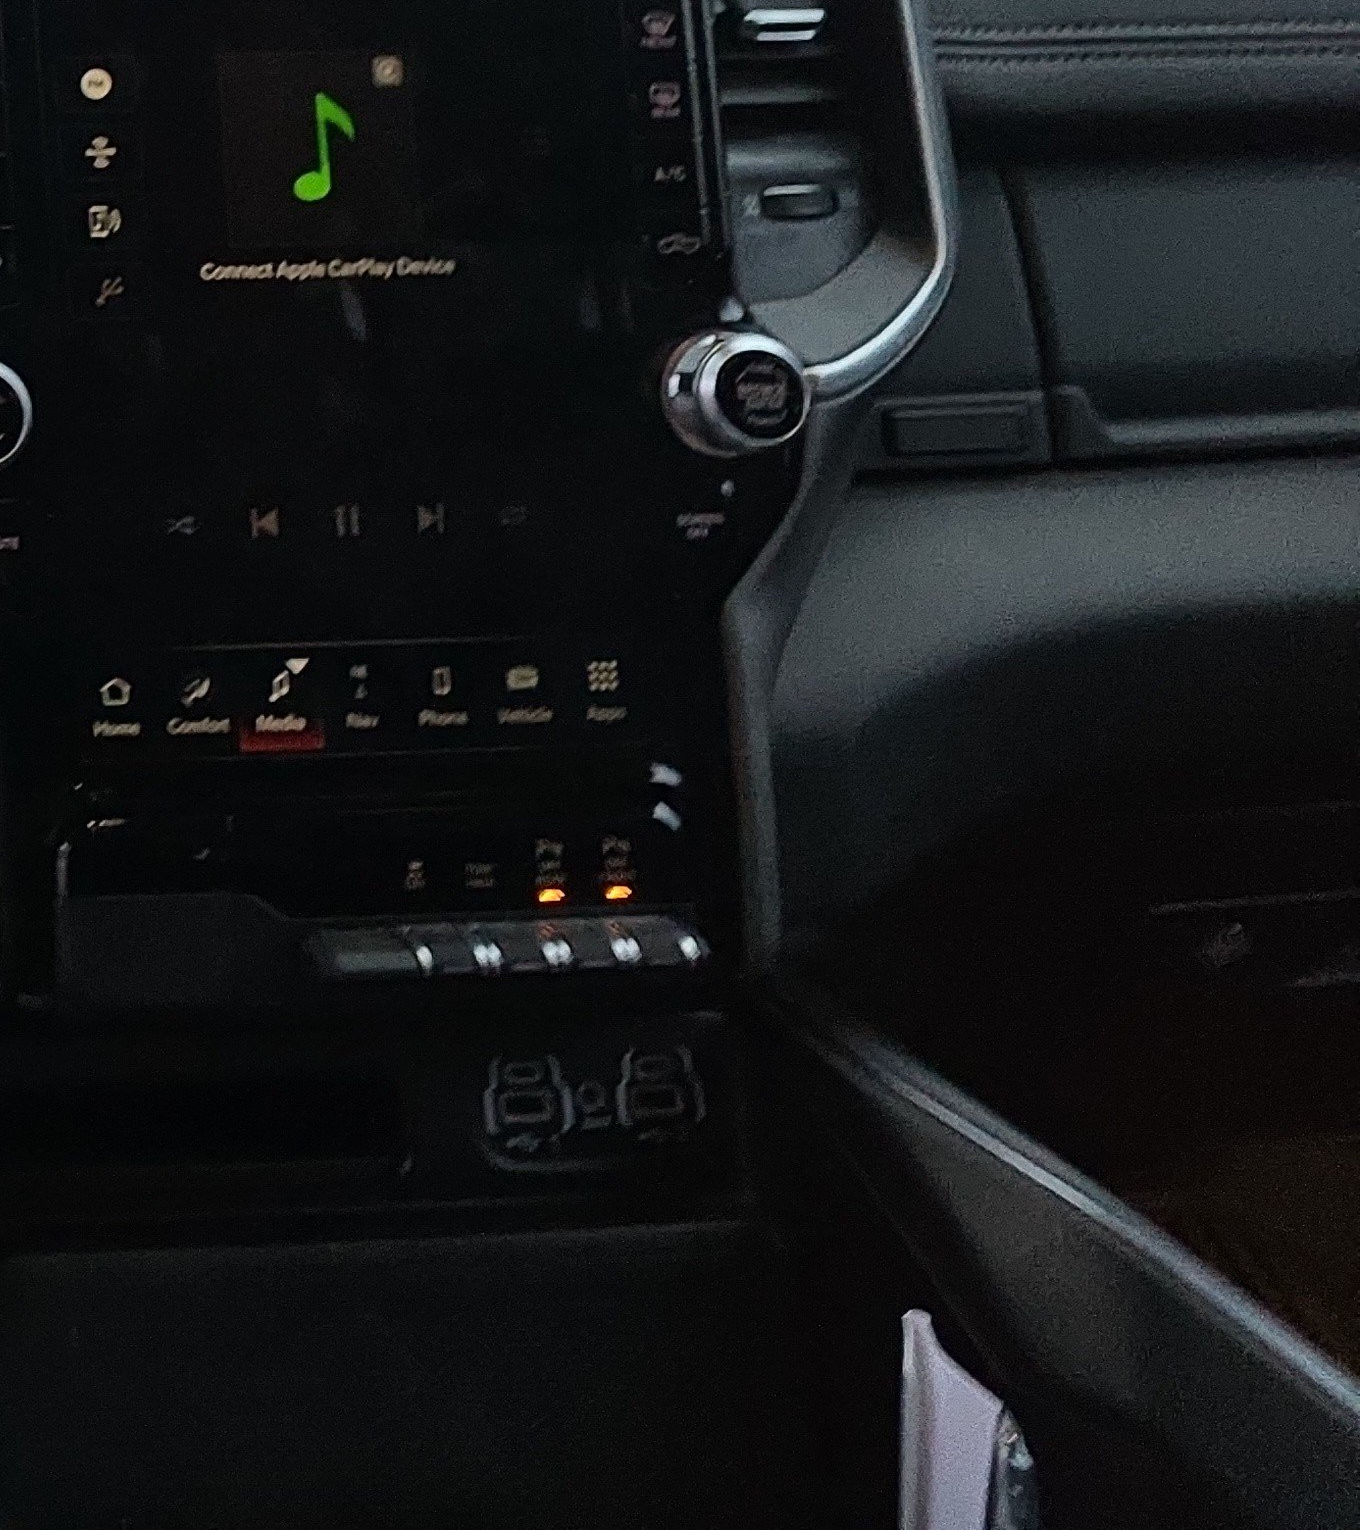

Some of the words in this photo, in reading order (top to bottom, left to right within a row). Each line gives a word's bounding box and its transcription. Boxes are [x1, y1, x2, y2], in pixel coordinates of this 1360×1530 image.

[200, 261, 274, 281] Connect
[276, 259, 327, 281] Apple
[328, 257, 396, 281] CarPlay
[396, 255, 456, 278] Device
[92, 720, 141, 738] Home
[255, 713, 307, 732] Media
